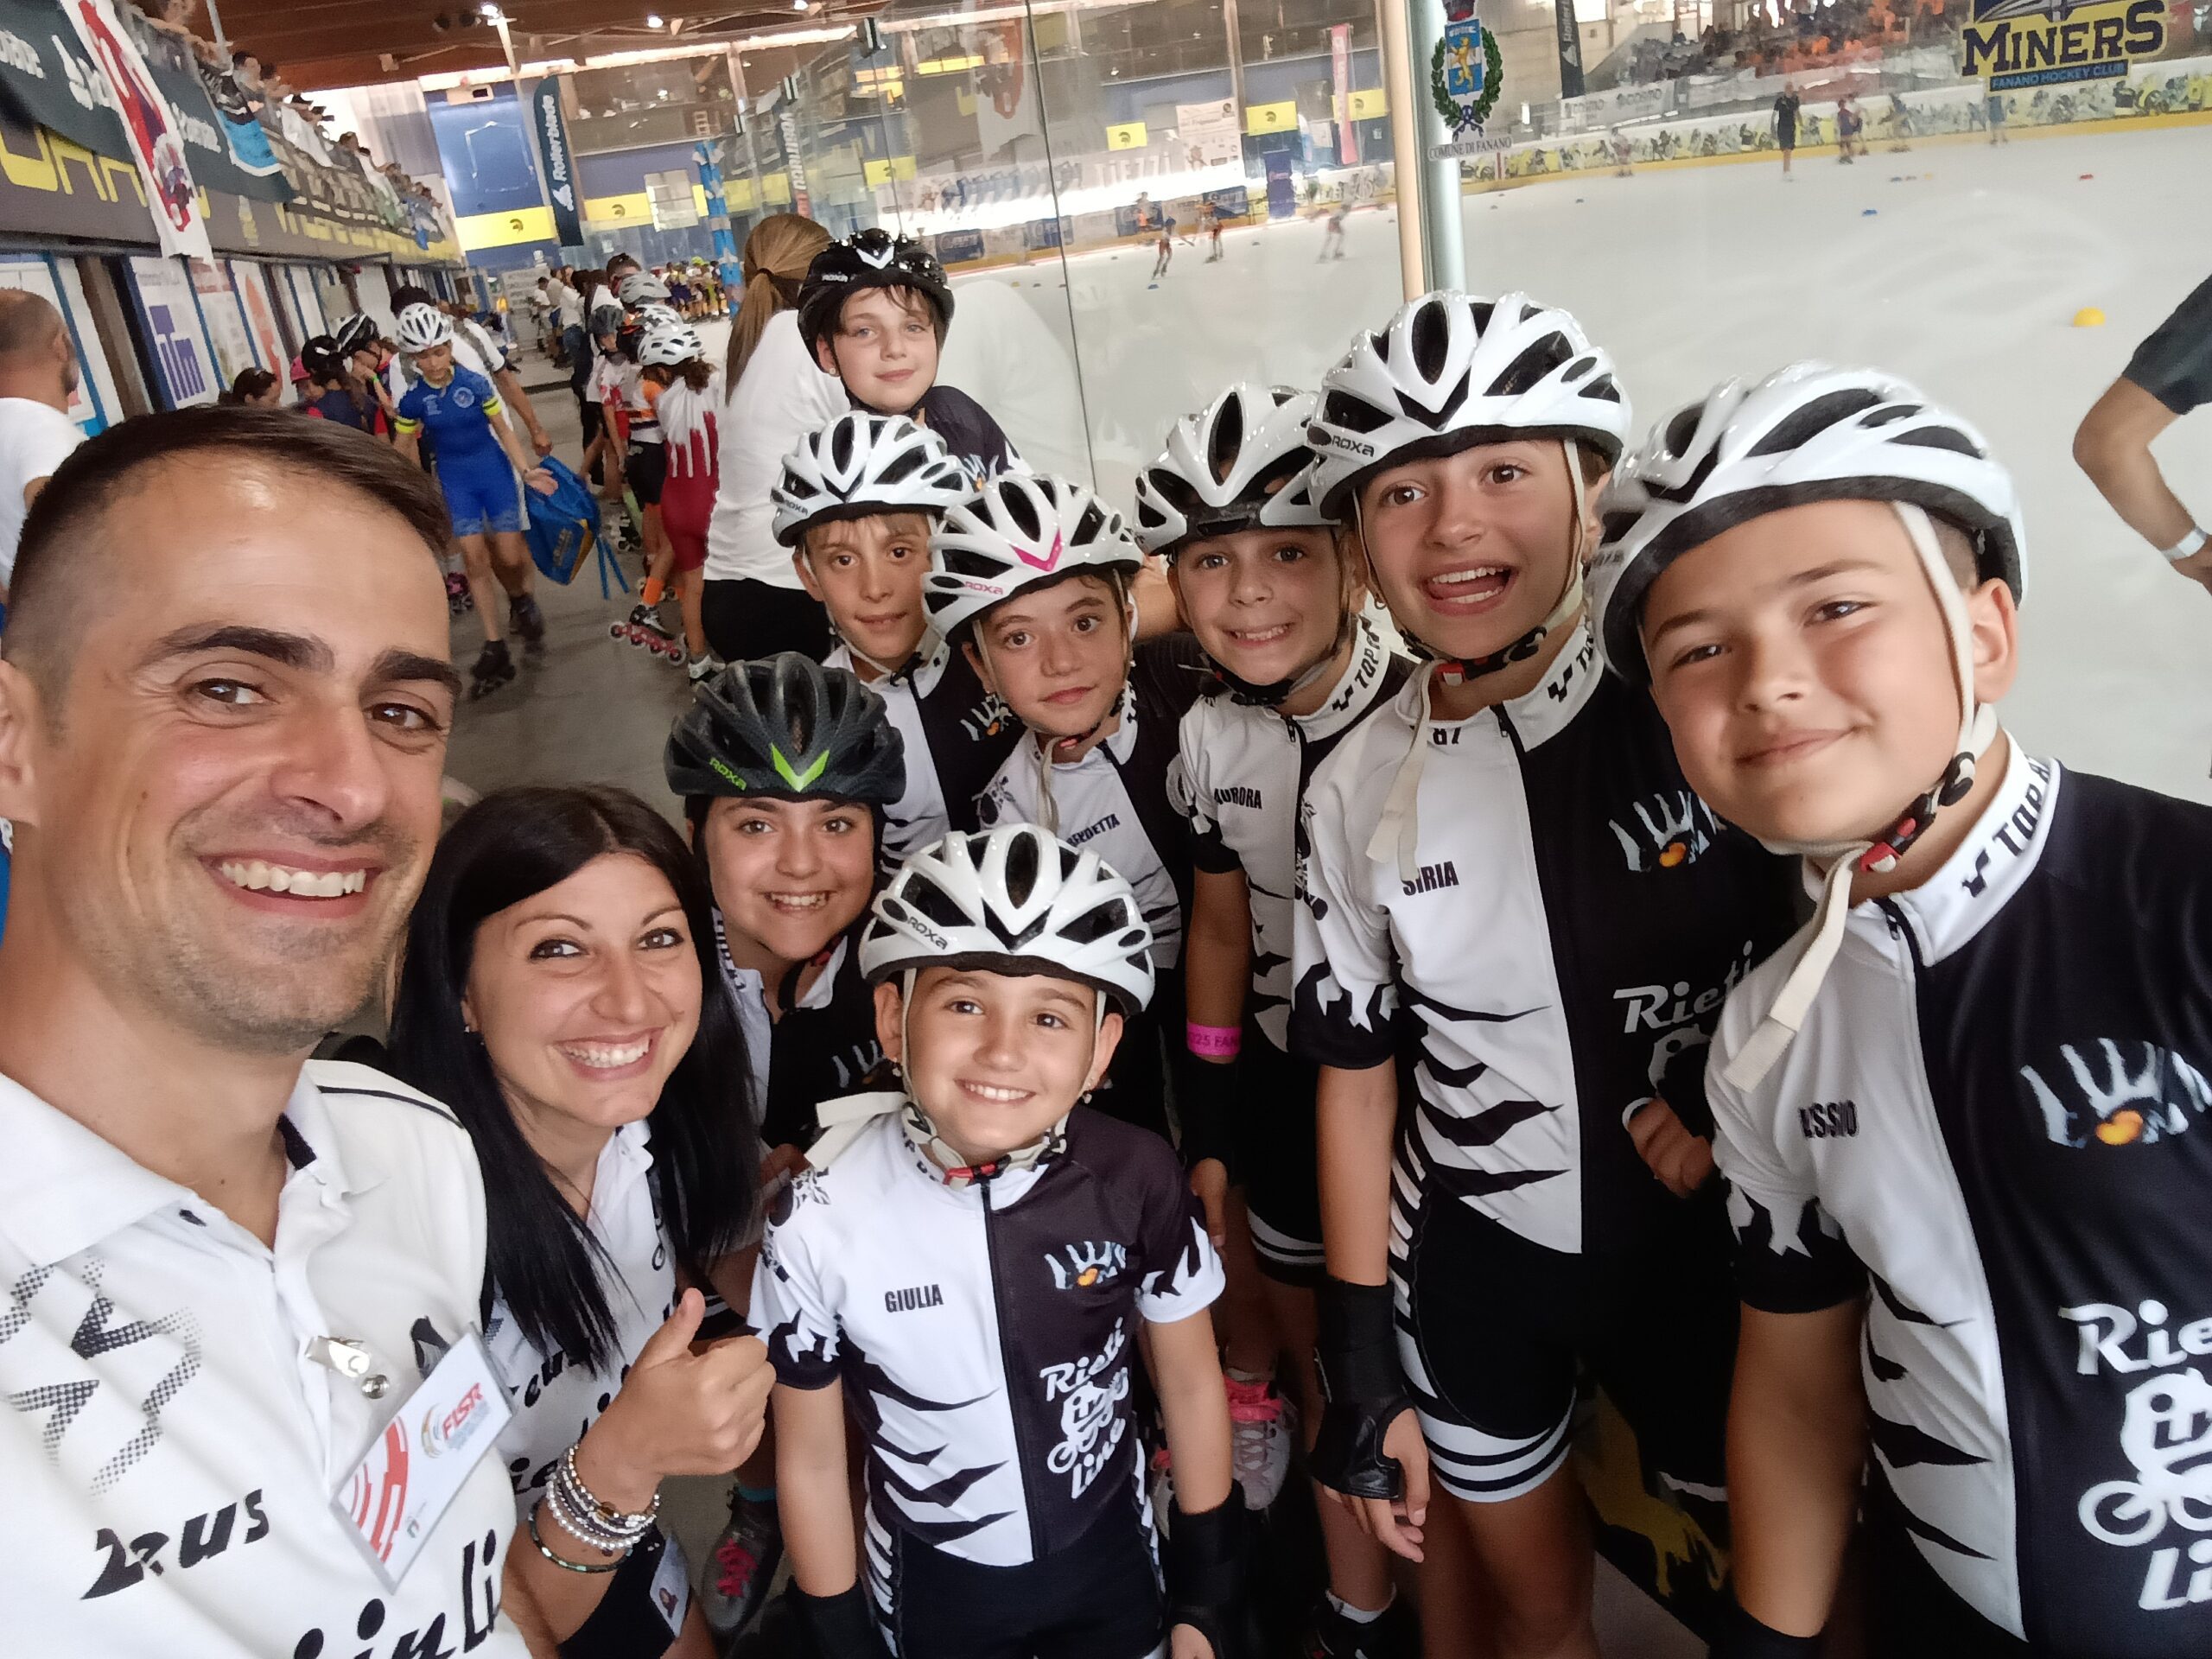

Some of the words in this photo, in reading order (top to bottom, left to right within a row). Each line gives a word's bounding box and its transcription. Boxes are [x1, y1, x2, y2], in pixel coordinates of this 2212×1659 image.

[1962, 0, 2165, 77] MINERS
[1992, 73, 2039, 89] FANANO
[2040, 68, 2089, 84] HOCKEY
[2093, 64, 2126, 76] CLUB
[1429, 143, 1465, 160] COMUNE
[1465, 142, 1476, 155] DI
[1476, 137, 1512, 152] FANANO
[1213, 786, 1262, 810] AURORA
[1401, 861, 1460, 897] SIRIA
[1612, 939, 1753, 1034] Rieti
[884, 1283, 944, 1313] GIULIA
[1039, 1316, 1125, 1402] Rieti
